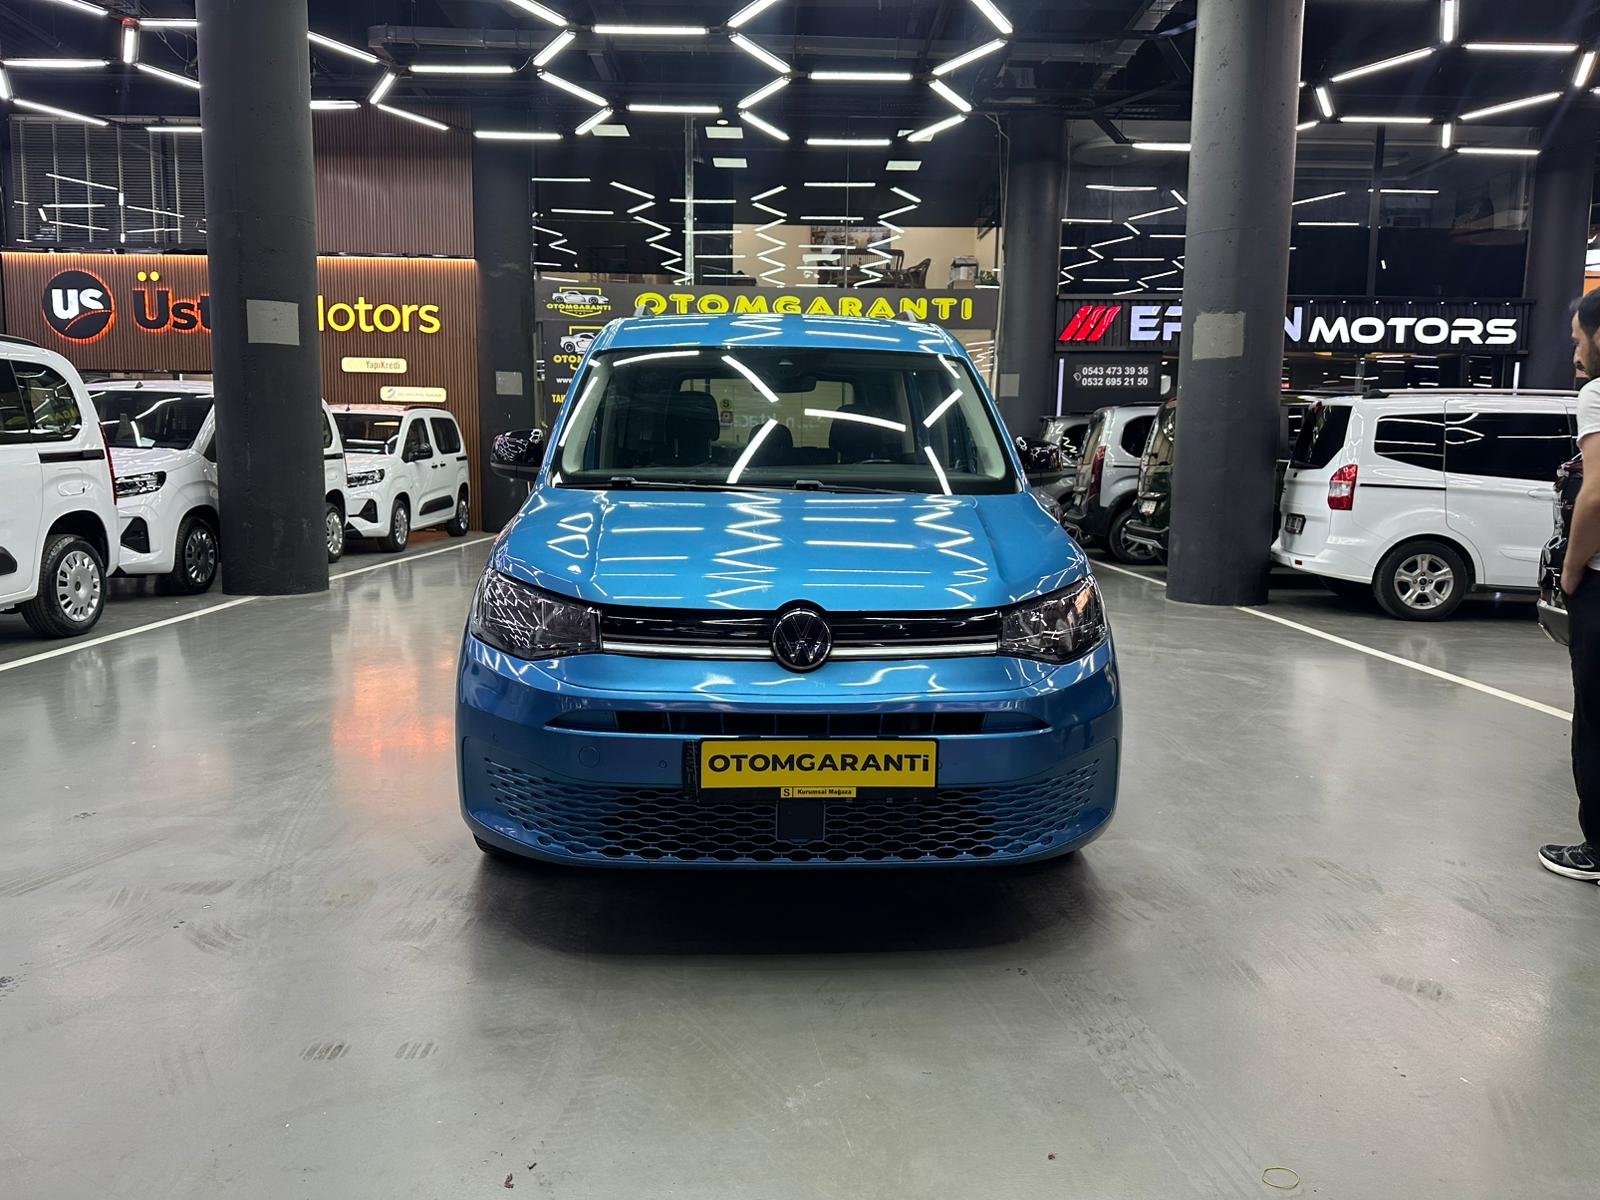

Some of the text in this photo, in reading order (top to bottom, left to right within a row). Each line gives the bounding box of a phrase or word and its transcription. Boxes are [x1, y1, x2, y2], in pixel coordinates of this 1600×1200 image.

[317, 295, 441, 334] otors
[634, 292, 973, 320] OTOMGARANTI
[1308, 316, 1518, 345] MOTORS
[1081, 377, 1103, 386] 0532
[1123, 377, 1134, 386] 21
[1137, 377, 1148, 386] 50
[1082, 366, 1104, 376] 0543
[1106, 366, 1122, 376] 473
[1124, 366, 1136, 376] 39
